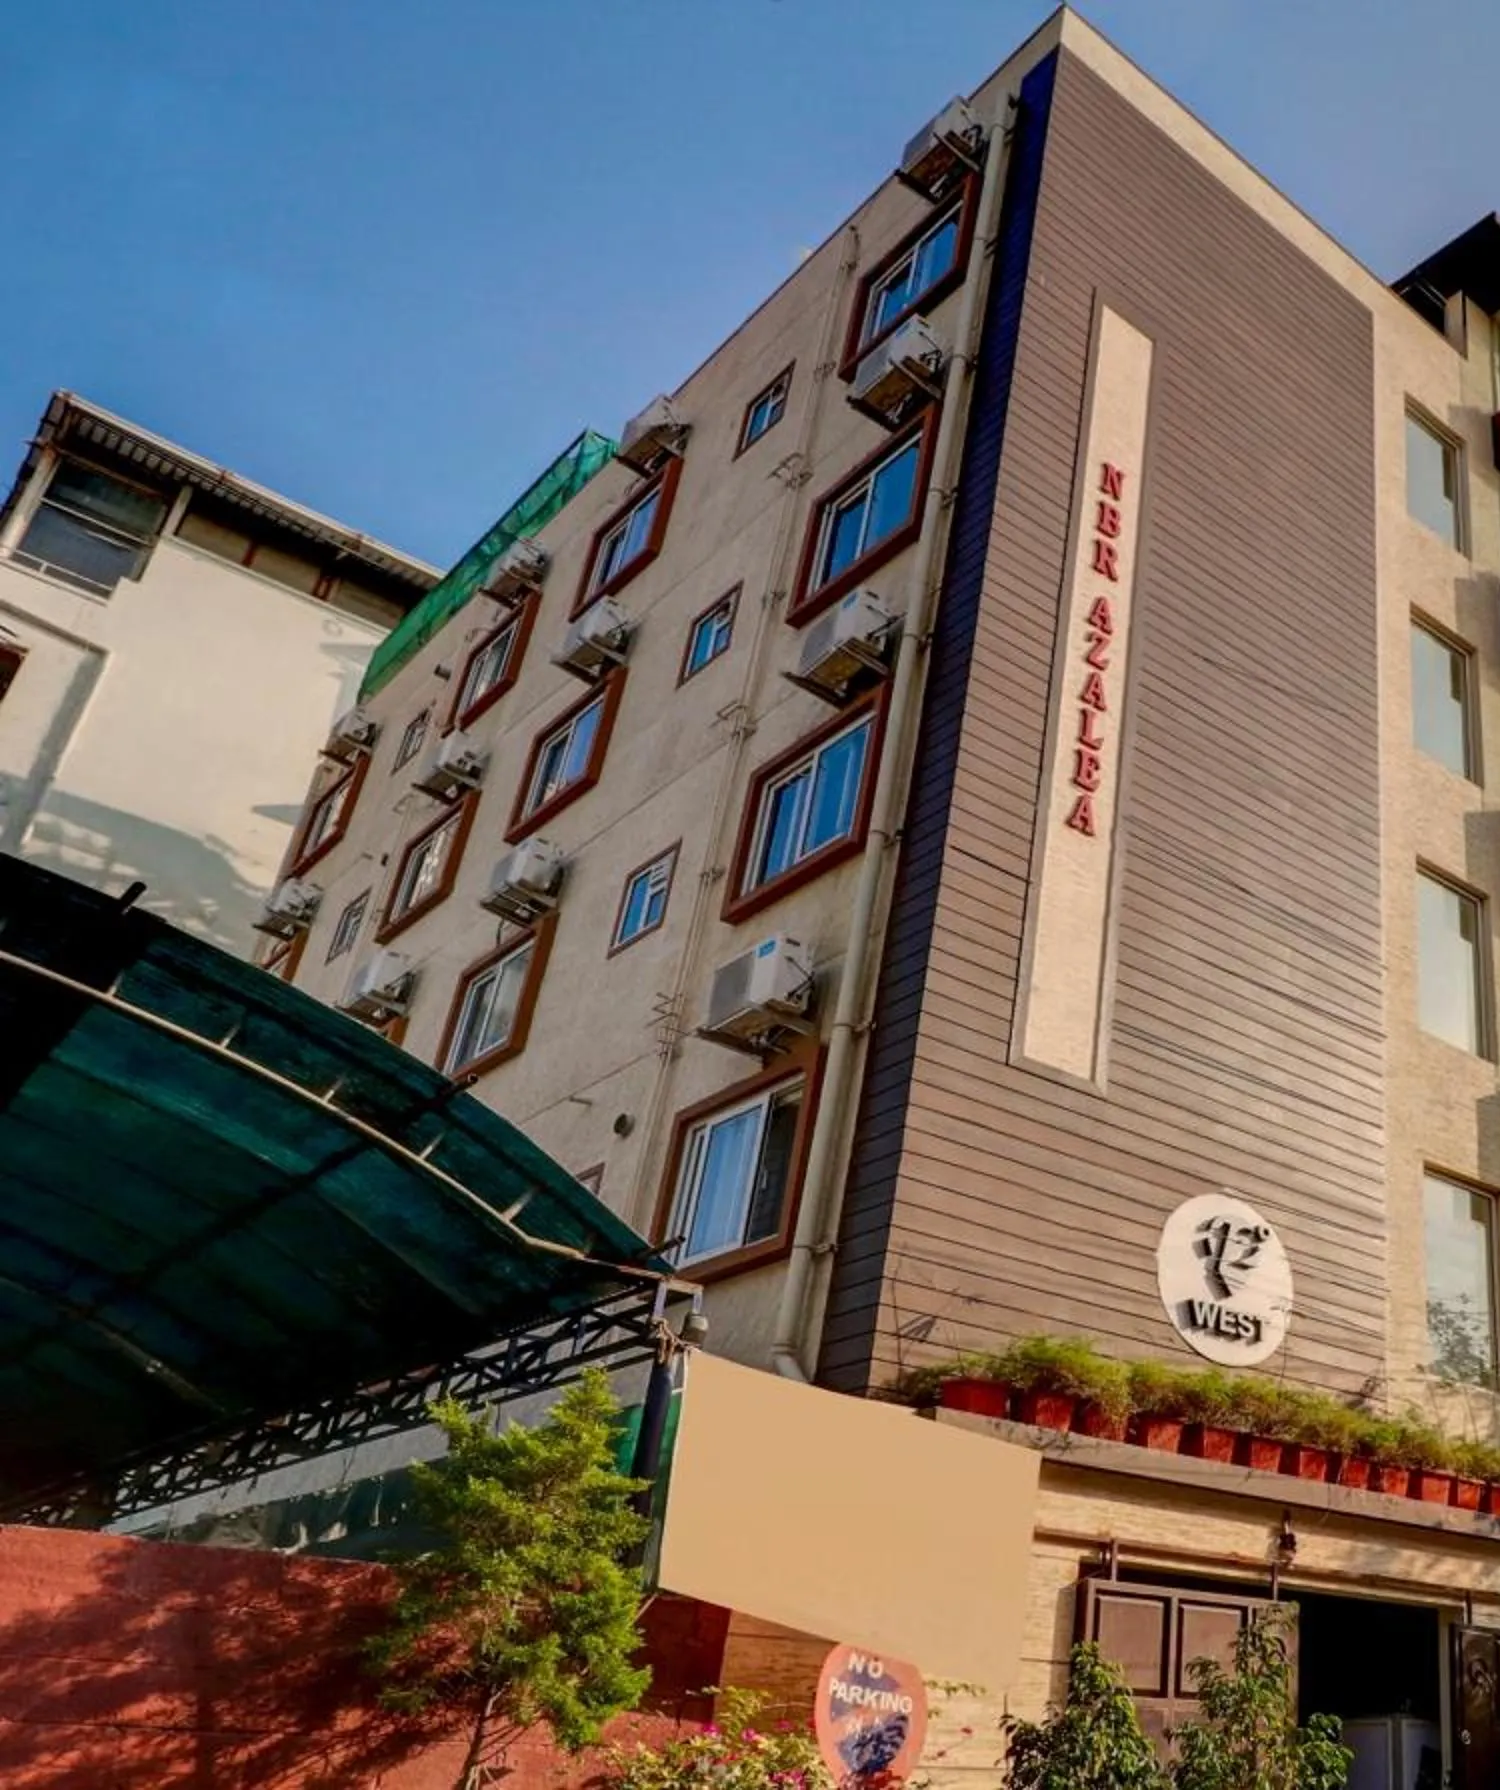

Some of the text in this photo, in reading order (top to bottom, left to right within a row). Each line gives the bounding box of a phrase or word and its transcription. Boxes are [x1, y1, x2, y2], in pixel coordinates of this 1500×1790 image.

[1065, 462, 1126, 837] NBR AZALEA
[1184, 1299, 1269, 1343] WEST
[847, 1650, 884, 1680] NO
[828, 1676, 913, 1715] PARKING
